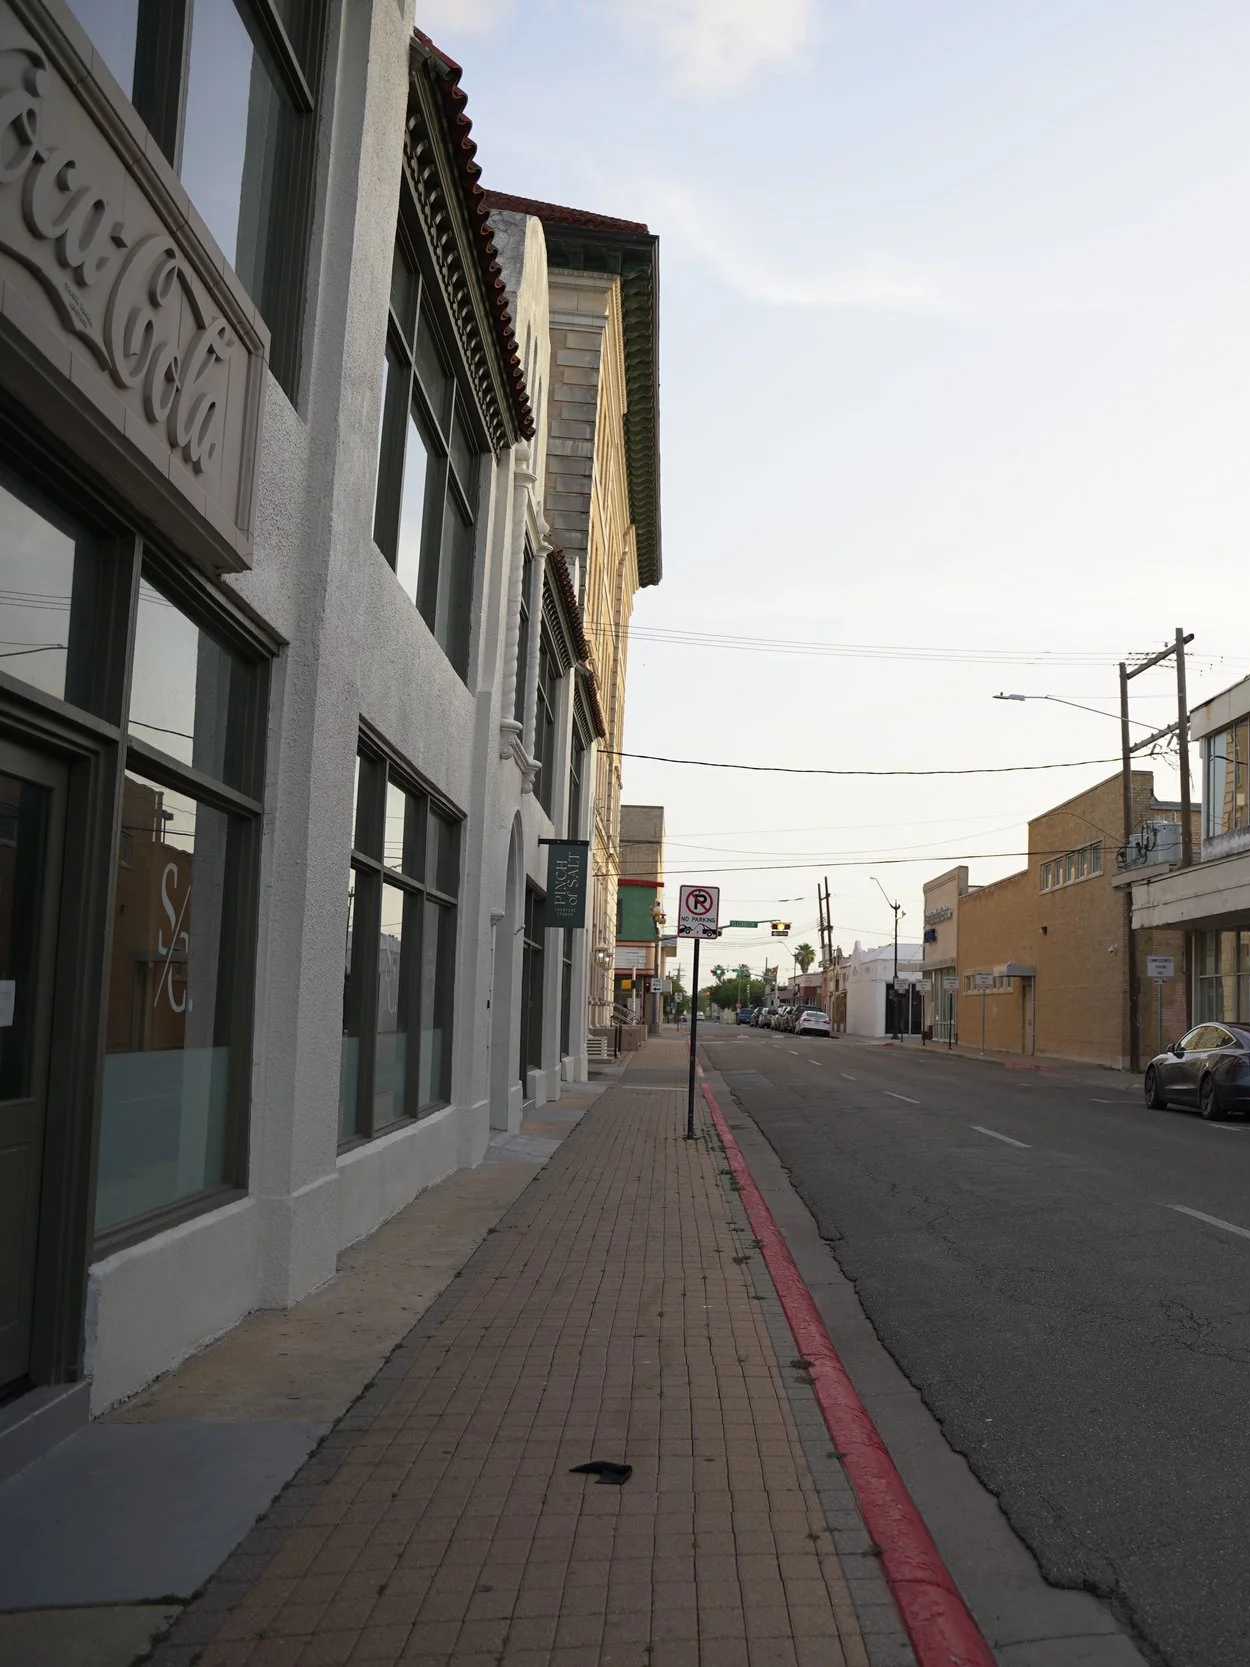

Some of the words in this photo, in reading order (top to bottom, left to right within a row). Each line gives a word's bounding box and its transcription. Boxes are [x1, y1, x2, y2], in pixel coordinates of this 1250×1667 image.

[0, 46, 234, 475] oca-Cola
[554, 860, 567, 905] PINCH
[568, 852, 580, 887] SALT
[567, 891, 578, 906] of
